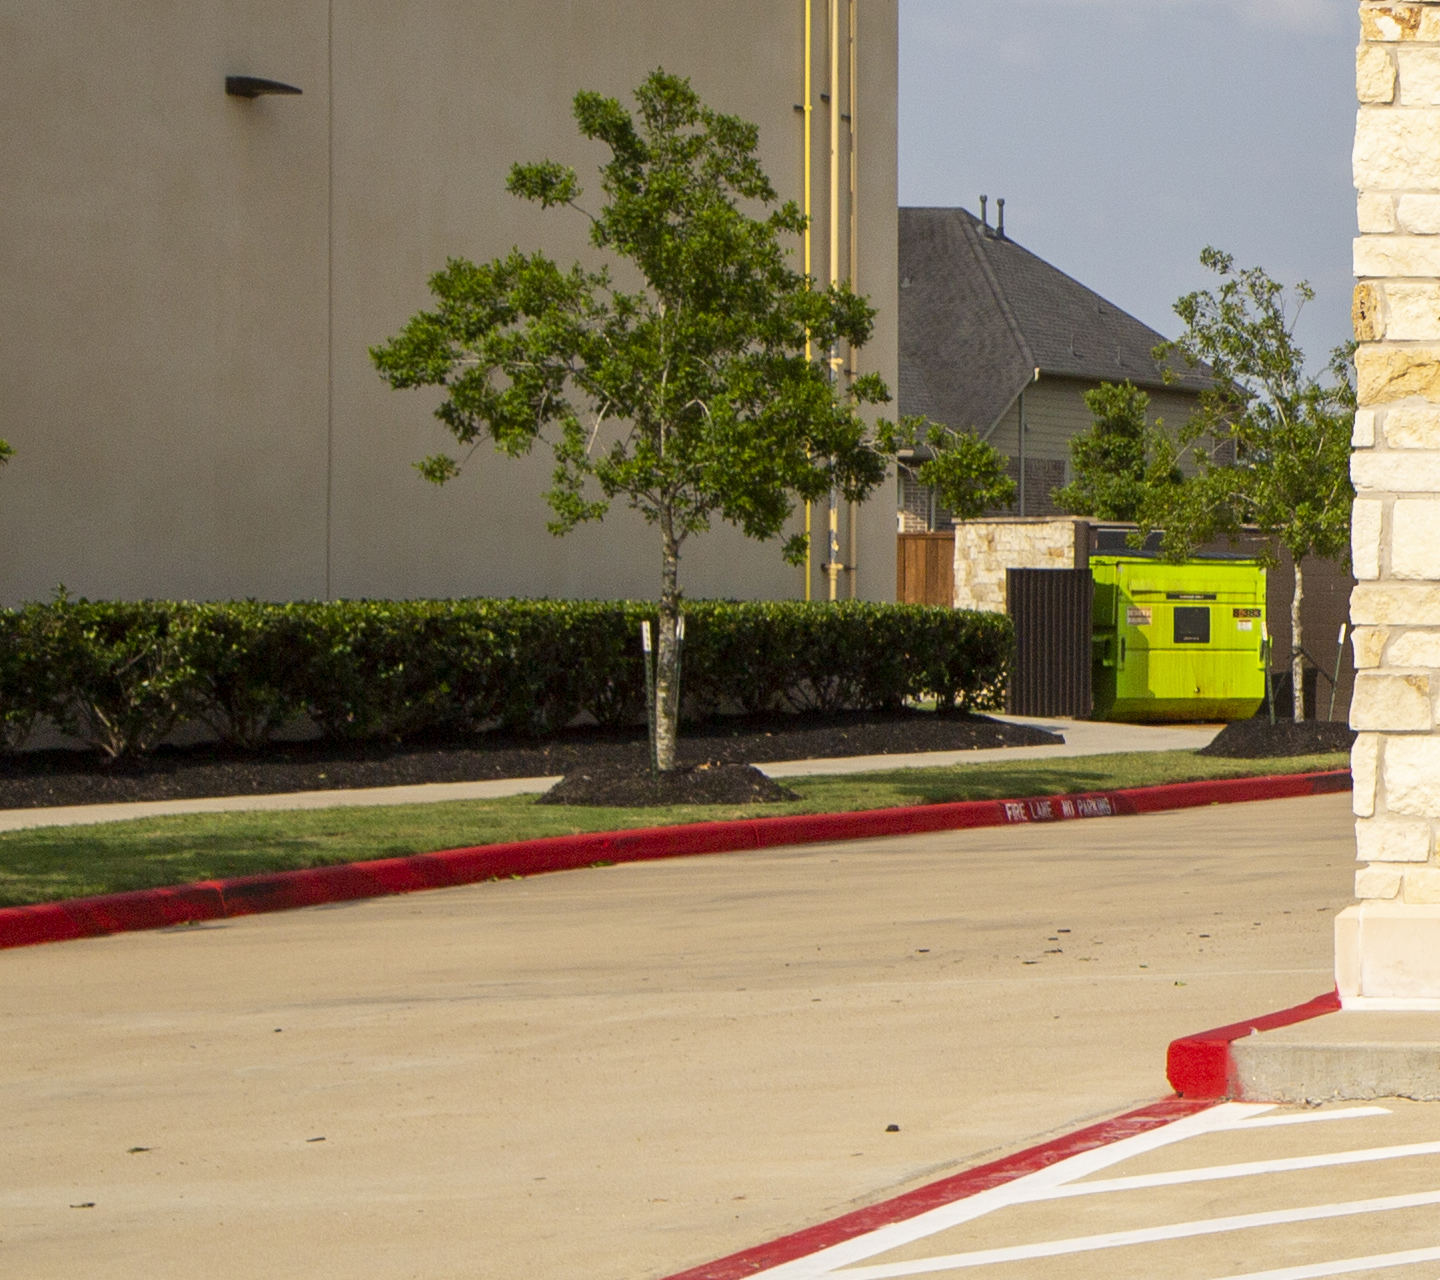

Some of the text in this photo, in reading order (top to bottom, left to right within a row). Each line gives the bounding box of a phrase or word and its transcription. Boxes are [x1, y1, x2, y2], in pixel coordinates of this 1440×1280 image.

[1004, 797, 1112, 821] FIRE LANE NO PARKING
